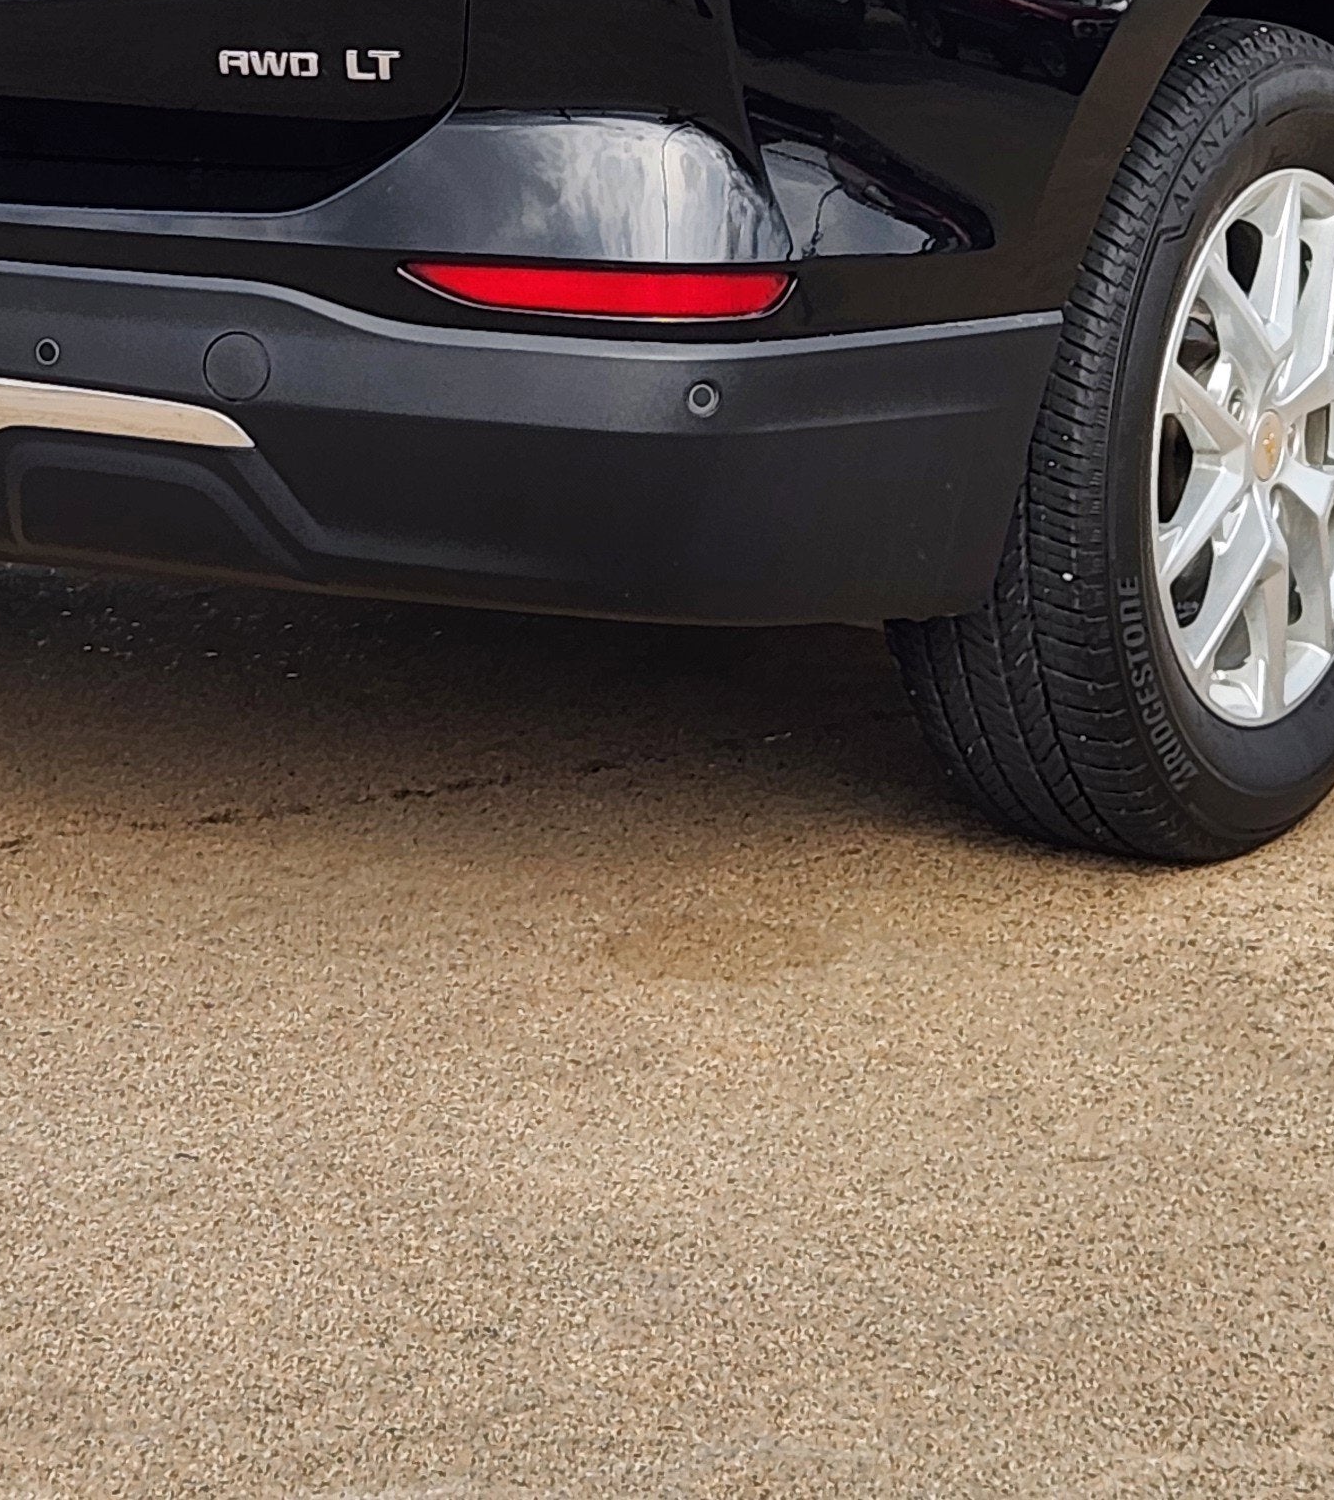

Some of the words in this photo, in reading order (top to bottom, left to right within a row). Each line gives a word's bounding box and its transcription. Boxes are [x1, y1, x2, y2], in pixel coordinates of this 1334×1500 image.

[219, 50, 318, 77] AWD
[346, 50, 401, 80] LT
[1173, 101, 1246, 216] ALENZA
[1118, 576, 1199, 791] BRIDGESTONE
